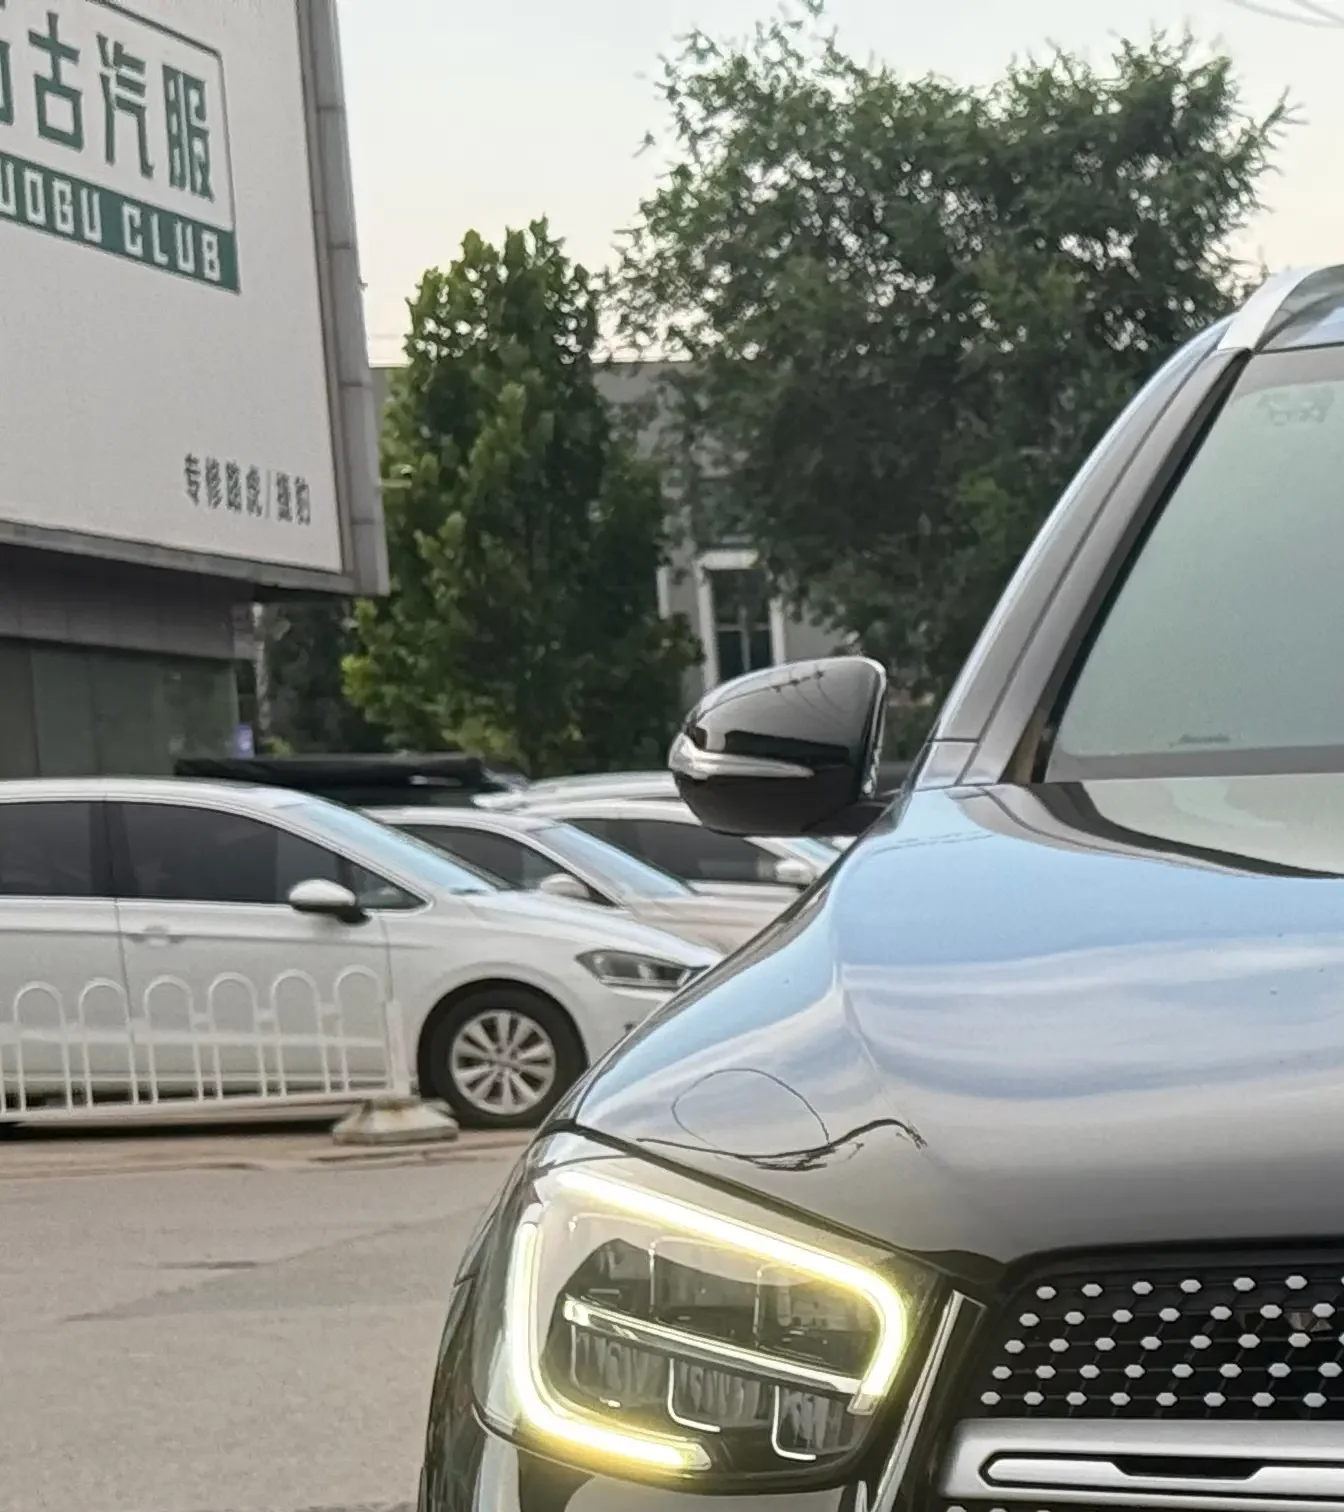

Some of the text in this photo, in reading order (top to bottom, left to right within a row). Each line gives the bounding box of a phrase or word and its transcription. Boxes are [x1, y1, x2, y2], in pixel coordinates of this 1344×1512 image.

[0, 5, 214, 203] 古汽服
[122, 201, 220, 281] CLUB
